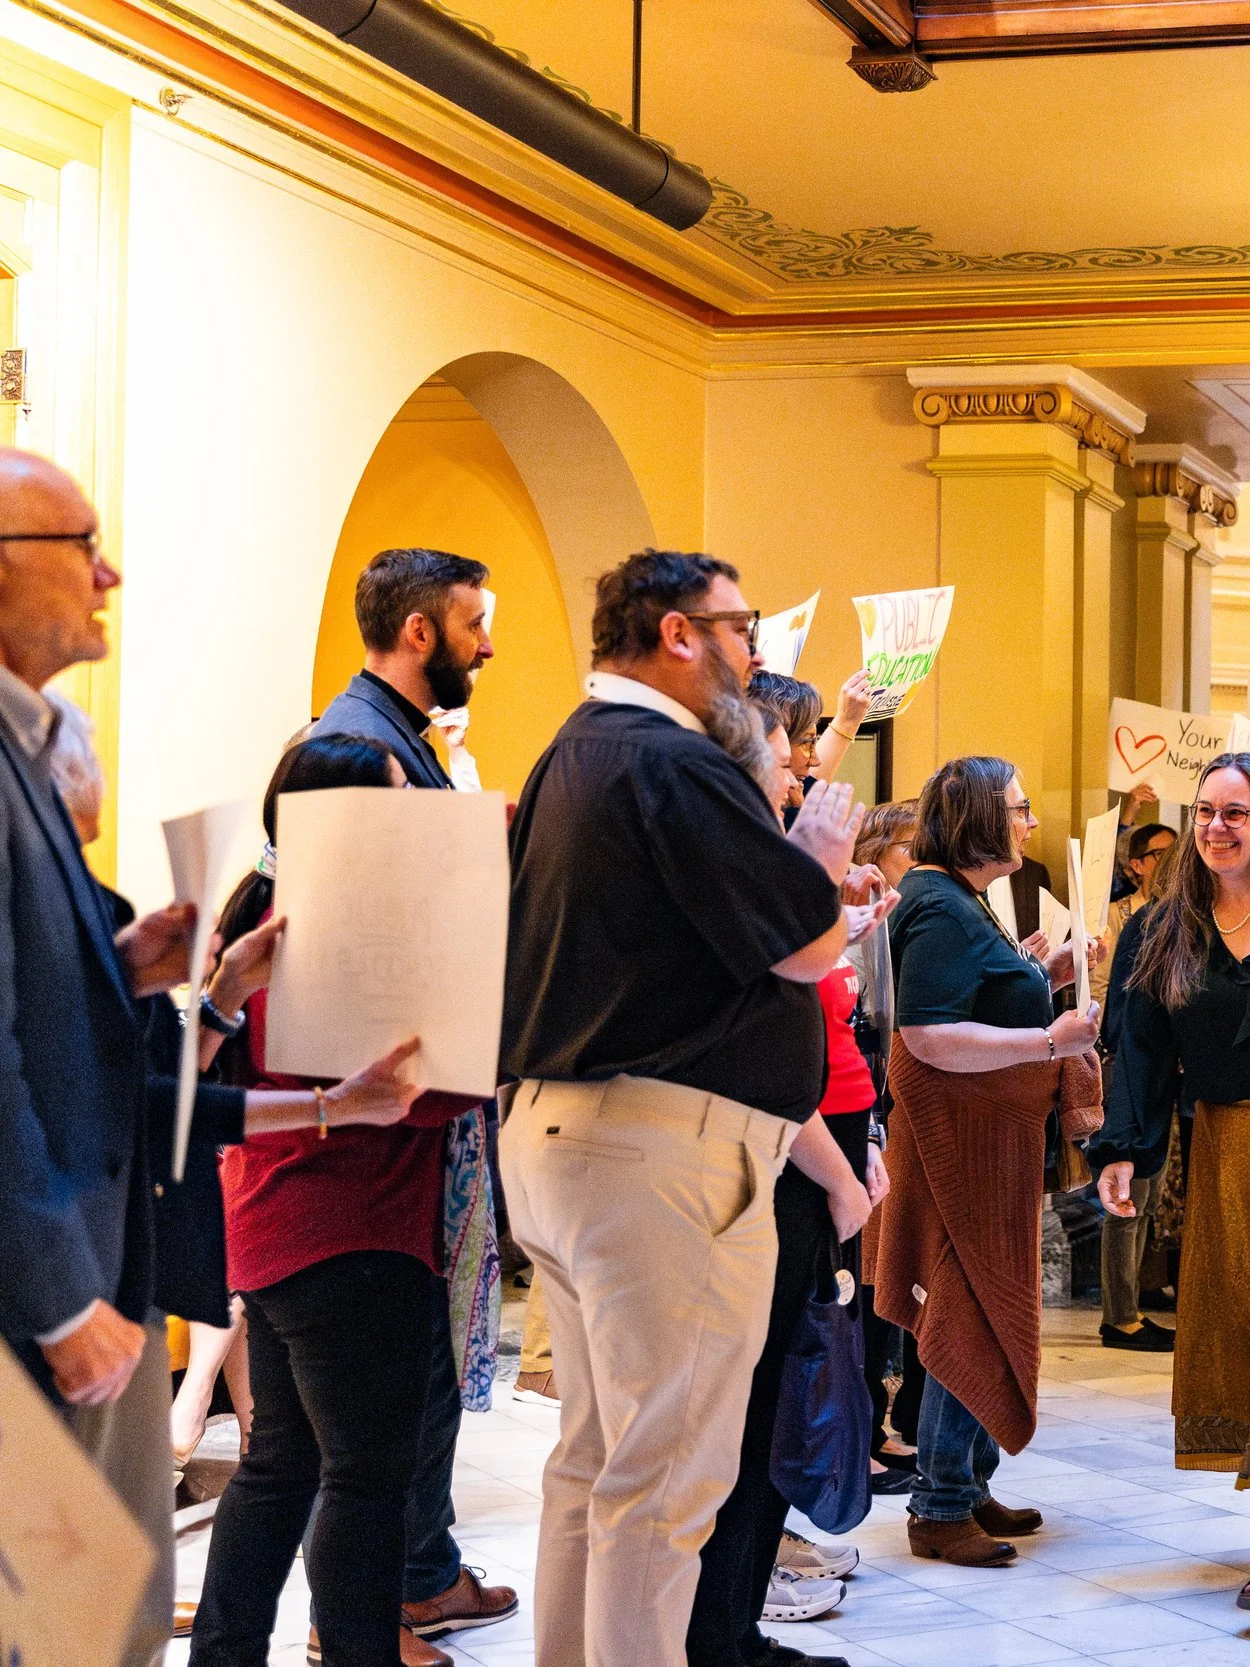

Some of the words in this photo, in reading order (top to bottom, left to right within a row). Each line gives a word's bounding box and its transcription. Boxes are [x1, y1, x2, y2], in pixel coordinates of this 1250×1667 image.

[879, 590, 947, 653] PUBLIC
[1178, 718, 1224, 749] Your
[1166, 750, 1209, 780] Neigh
